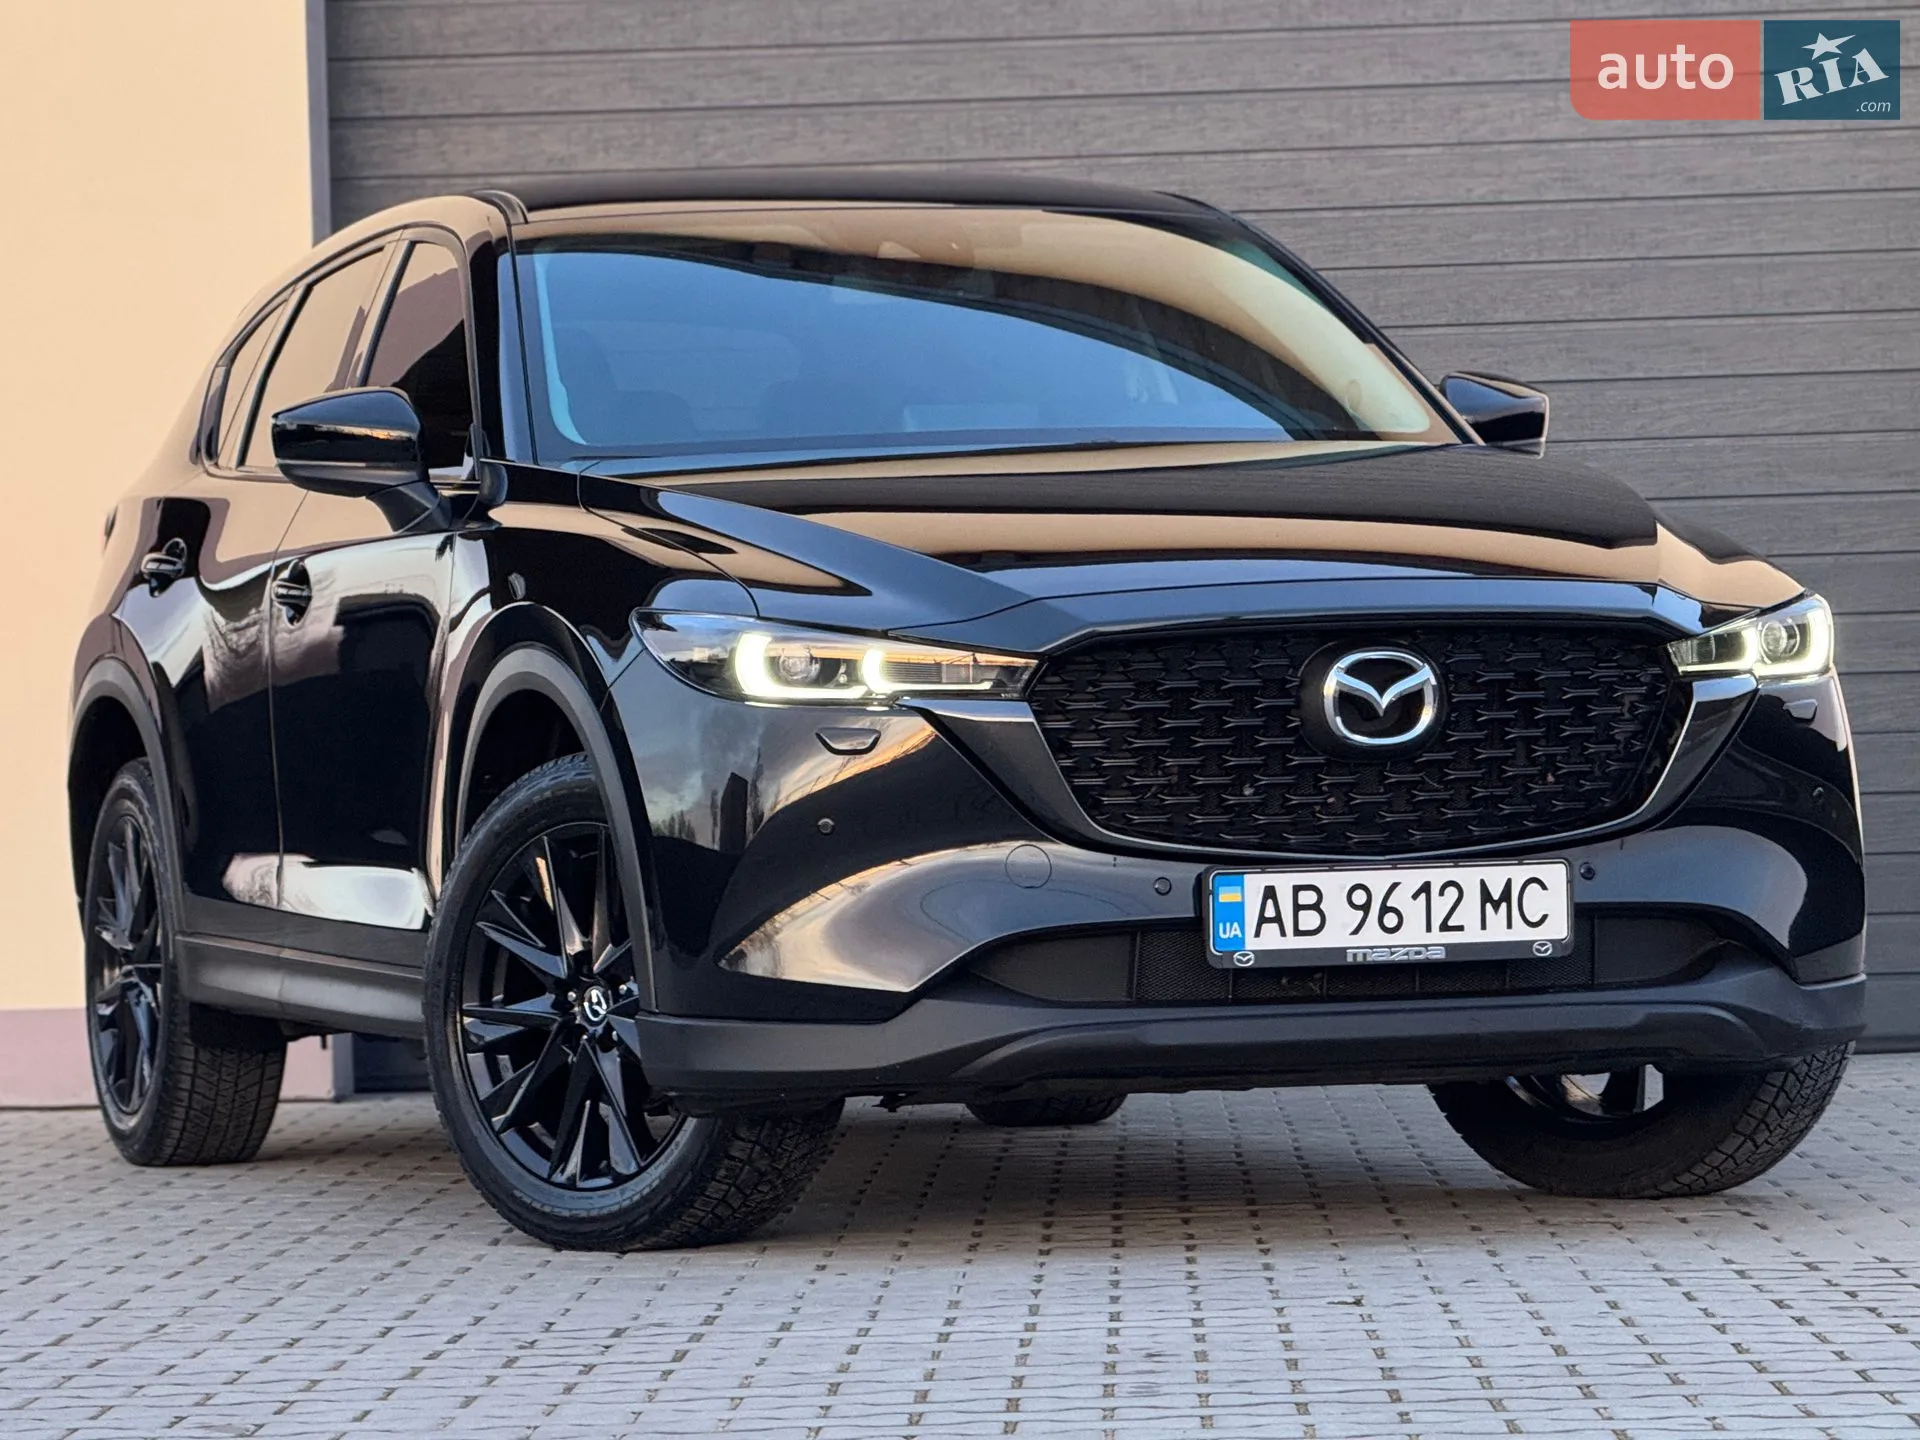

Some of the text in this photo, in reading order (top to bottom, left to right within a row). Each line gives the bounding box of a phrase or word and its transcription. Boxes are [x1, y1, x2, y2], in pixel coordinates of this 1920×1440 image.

[1254, 877, 1548, 938] AB 9612 MC
[1219, 922, 1242, 939] UA
